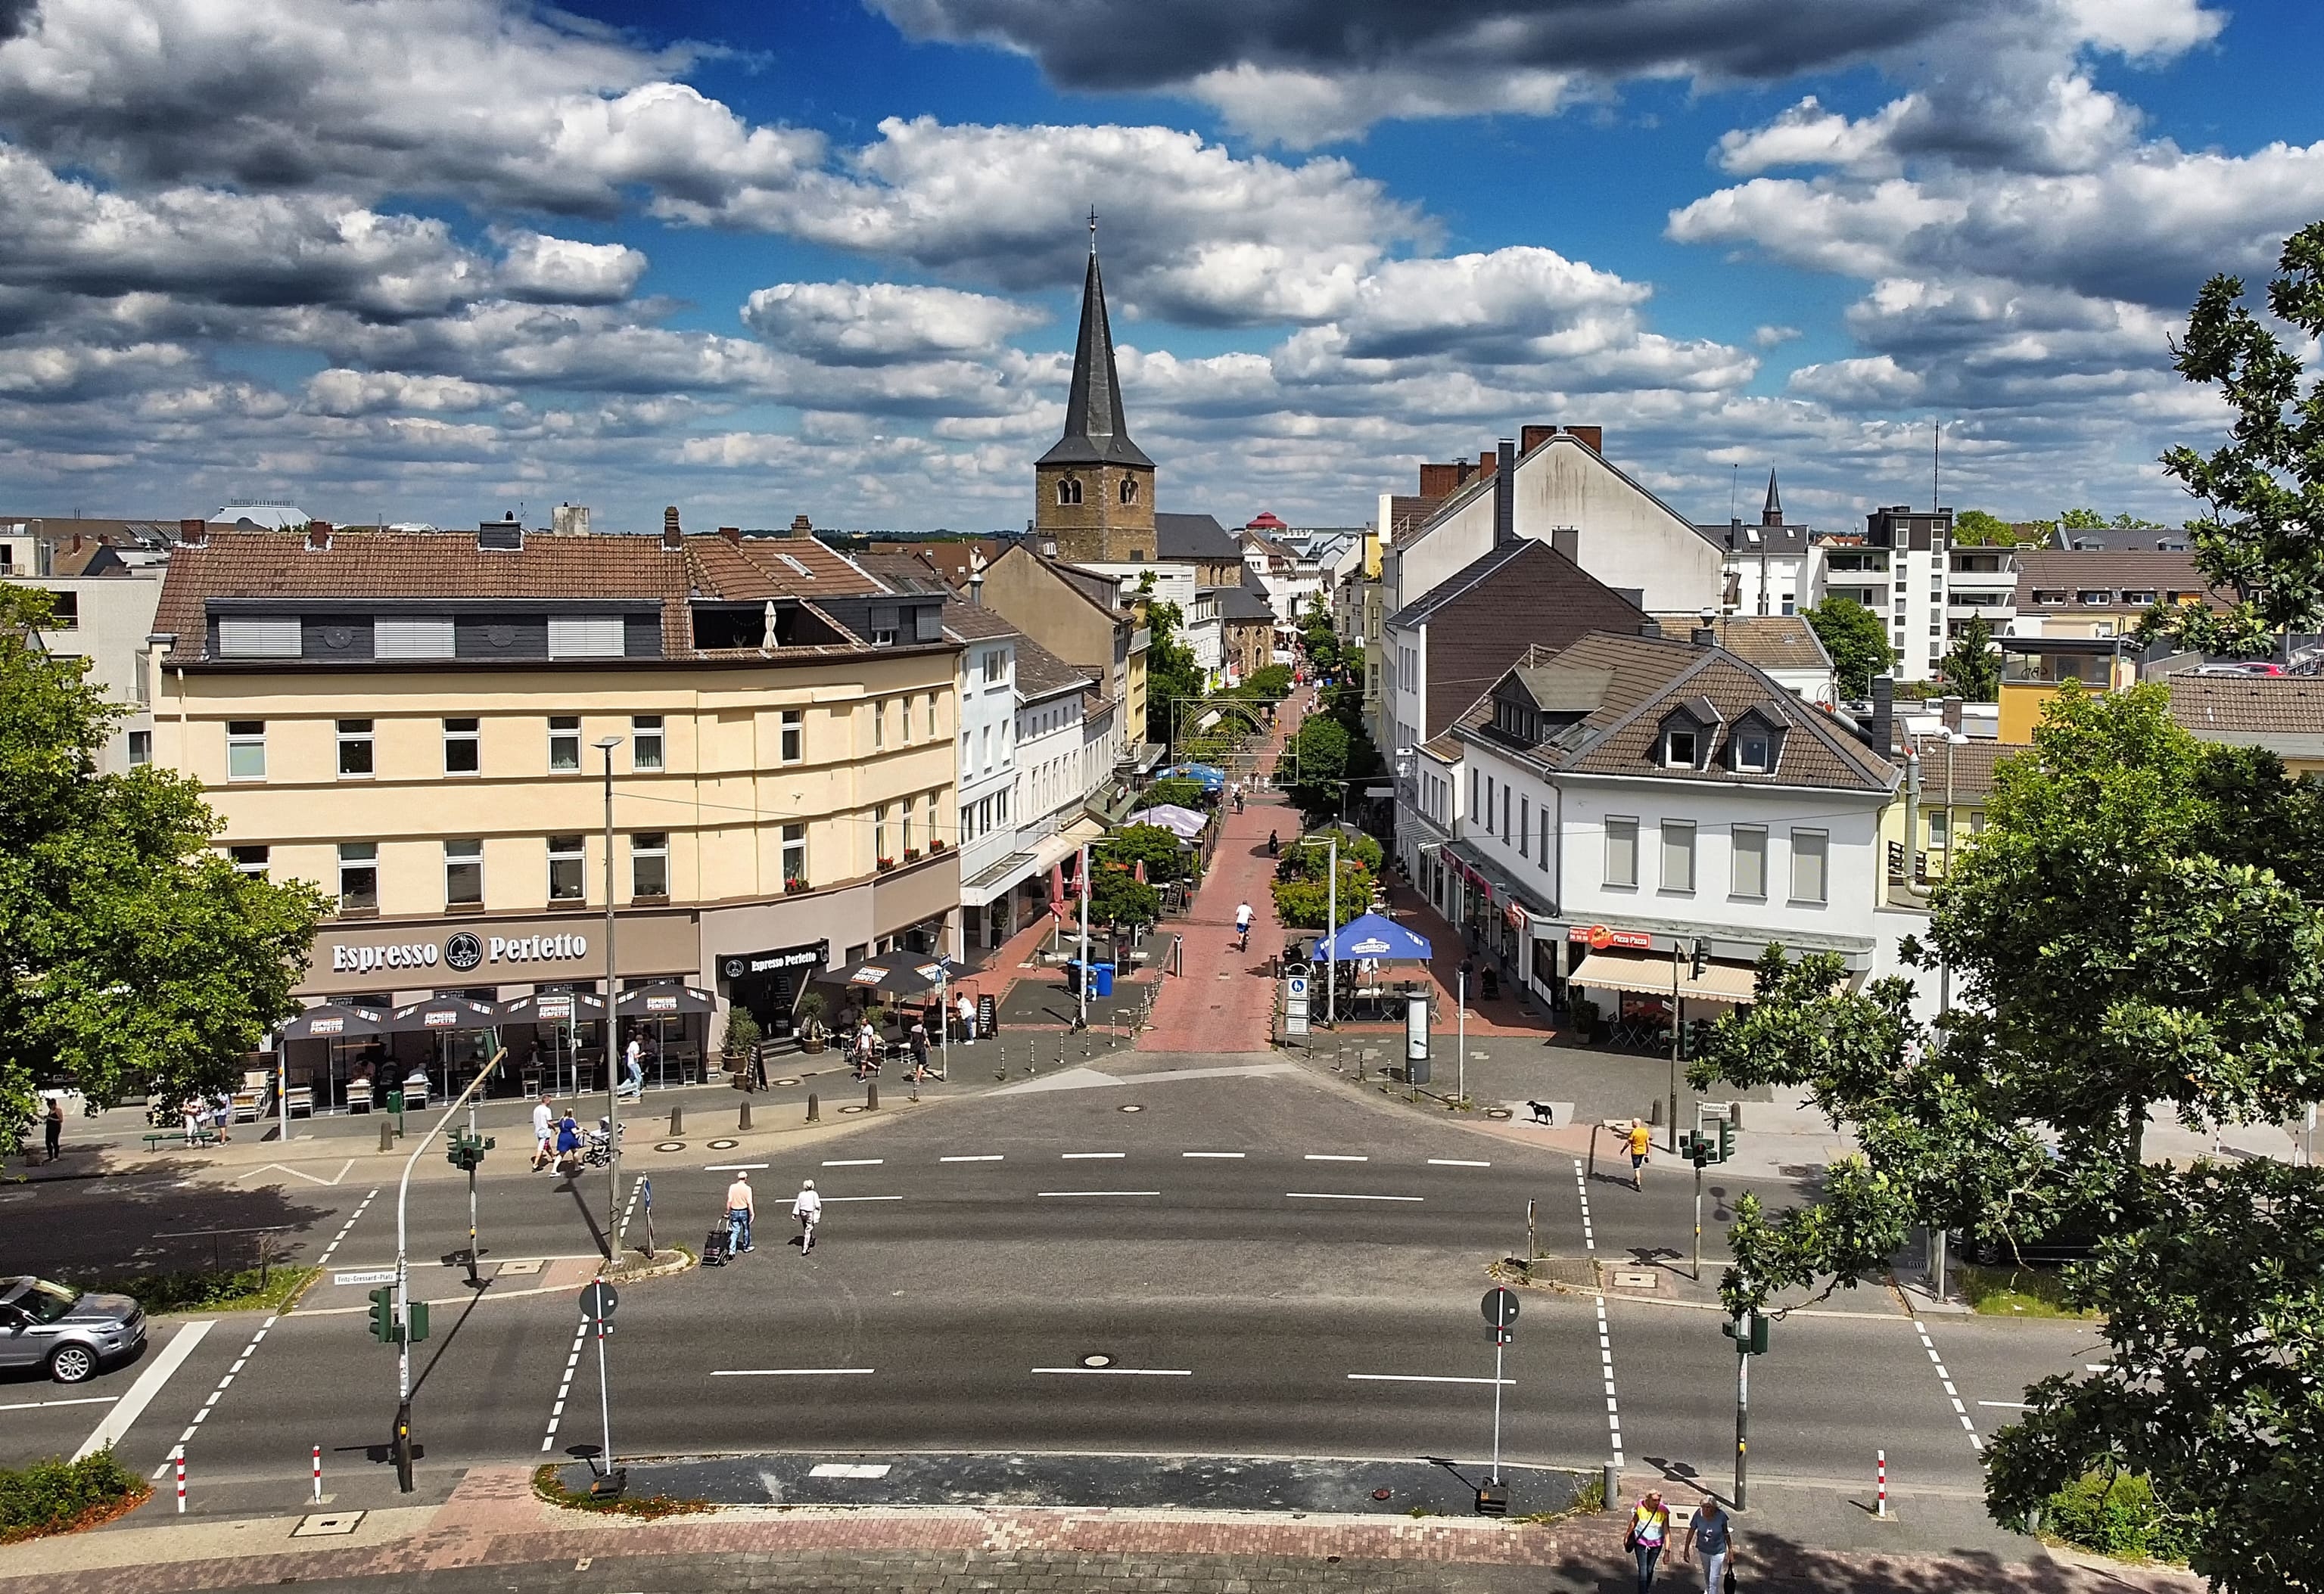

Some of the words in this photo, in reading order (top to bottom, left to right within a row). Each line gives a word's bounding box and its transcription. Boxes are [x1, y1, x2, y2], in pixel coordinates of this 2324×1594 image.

[1613, 934, 1629, 943] Pizza
[333, 943, 439, 973] Espresso
[489, 933, 587, 962] Perfetto
[751, 958, 784, 971] Espresso
[785, 952, 817, 966] Perfetto
[425, 1011, 457, 1020] ESPRESSO
[311, 1018, 344, 1027] ESPRESSO
[338, 1274, 393, 1282] Fritz-Gressard-Platz
